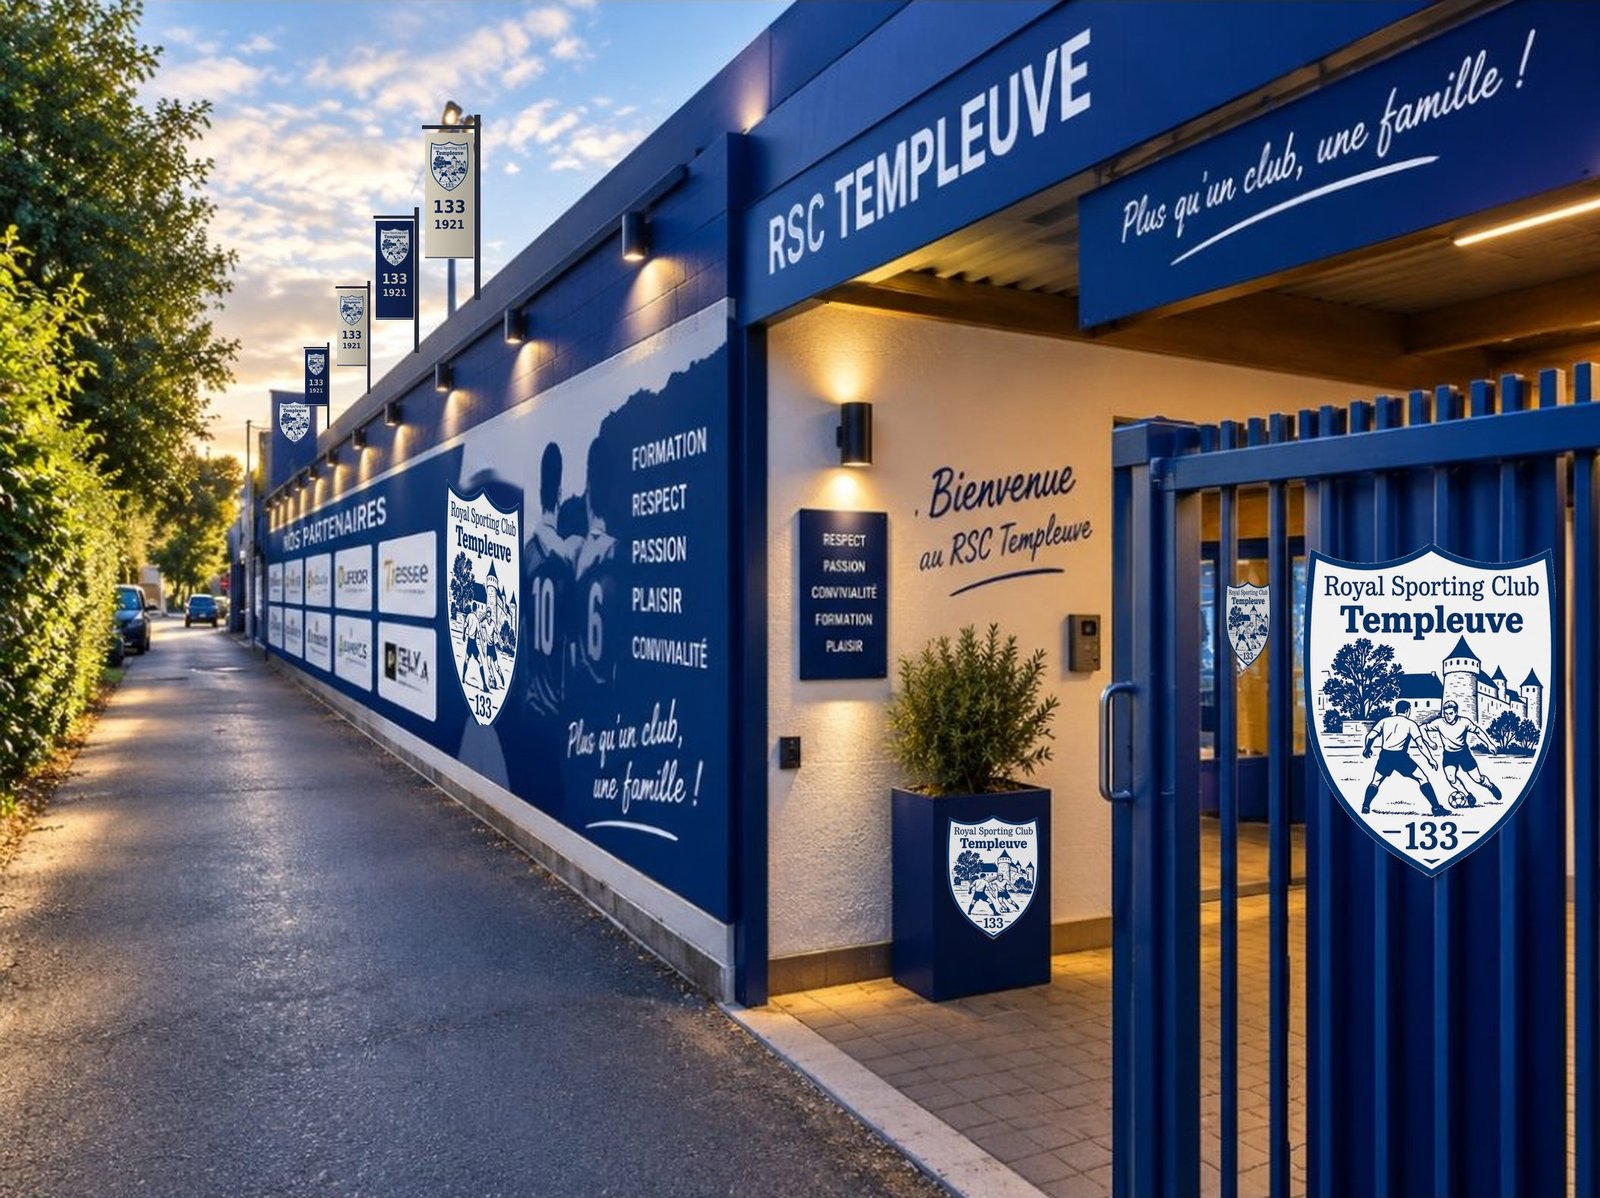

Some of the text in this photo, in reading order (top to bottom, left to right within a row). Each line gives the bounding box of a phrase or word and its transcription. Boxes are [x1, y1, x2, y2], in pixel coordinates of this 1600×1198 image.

[1121, 28, 1537, 243] Plus qu'un club, une famille !
[769, 28, 1091, 275] RSC TEMPLEUVE
[434, 200, 465, 214] 133
[434, 219, 465, 230] 1921
[382, 273, 407, 284] 133
[383, 288, 407, 297] 1921
[342, 330, 362, 340] 133
[309, 378, 324, 386] 133
[632, 426, 707, 471] FORMATION
[632, 483, 687, 517] RESPECT
[929, 466, 1076, 518] Bienvenue
[302, 496, 387, 547] PARTENAIRES
[450, 500, 516, 537] Royal Sporting Club
[455, 524, 512, 563] Templeuve
[632, 535, 687, 564] PASSION
[823, 533, 866, 547] RESPECT
[920, 513, 1093, 571] au RSC Templeuve
[823, 559, 866, 573] PASSION
[632, 587, 682, 613] PLAISIR
[811, 583, 878, 599] CONVIVIALITÉ
[1231, 596, 1265, 607] Templeuve
[1324, 575, 1540, 602] Royal Sporting Club
[531, 576, 555, 655] 10
[587, 581, 604, 661] 6
[815, 613, 873, 627] FORMATION
[1340, 605, 1524, 640] Templeuve
[632, 635, 708, 669] CONVIVIALITÉ
[826, 640, 863, 653] PLAISIR
[567, 698, 683, 769] Plus qu'un club,
[593, 759, 703, 815] une famille !
[954, 826, 1034, 838] Royal Sporting Club
[960, 837, 1028, 851] Templeuve
